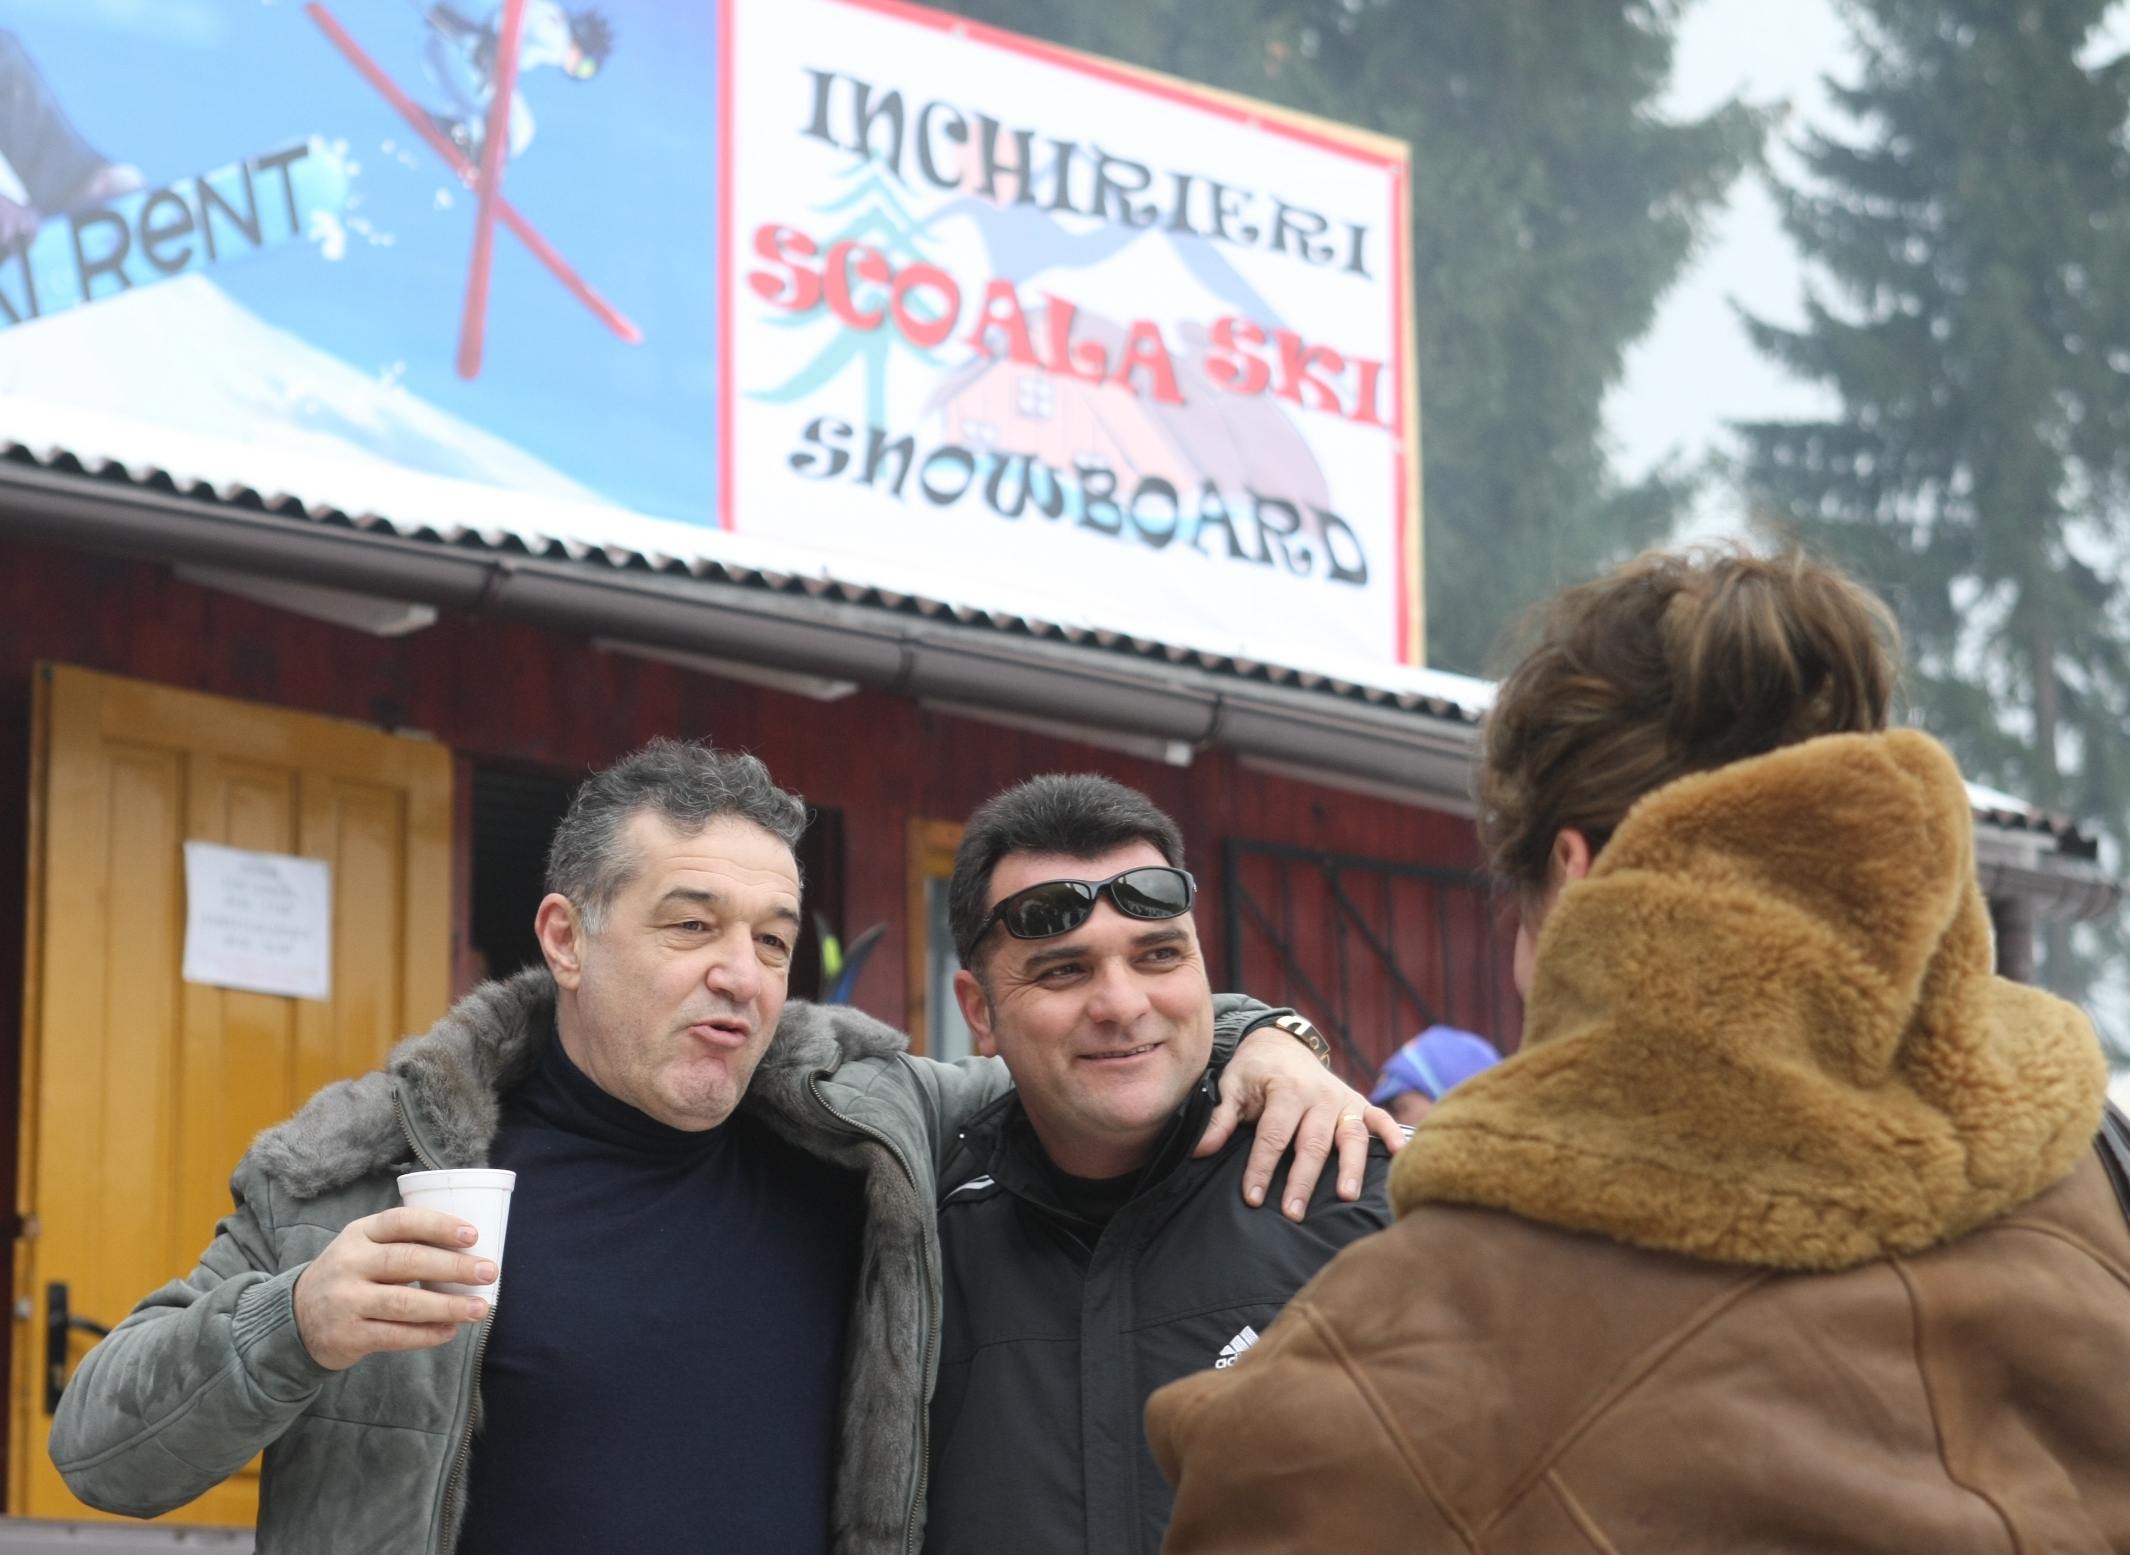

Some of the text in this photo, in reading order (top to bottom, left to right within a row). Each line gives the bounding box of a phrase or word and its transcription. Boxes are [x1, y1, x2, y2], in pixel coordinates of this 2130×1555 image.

[798, 68, 1372, 279] INCHIRIERI
[749, 223, 1394, 429] SCOALA SKI
[788, 416, 1370, 585] SNOWBOARD
